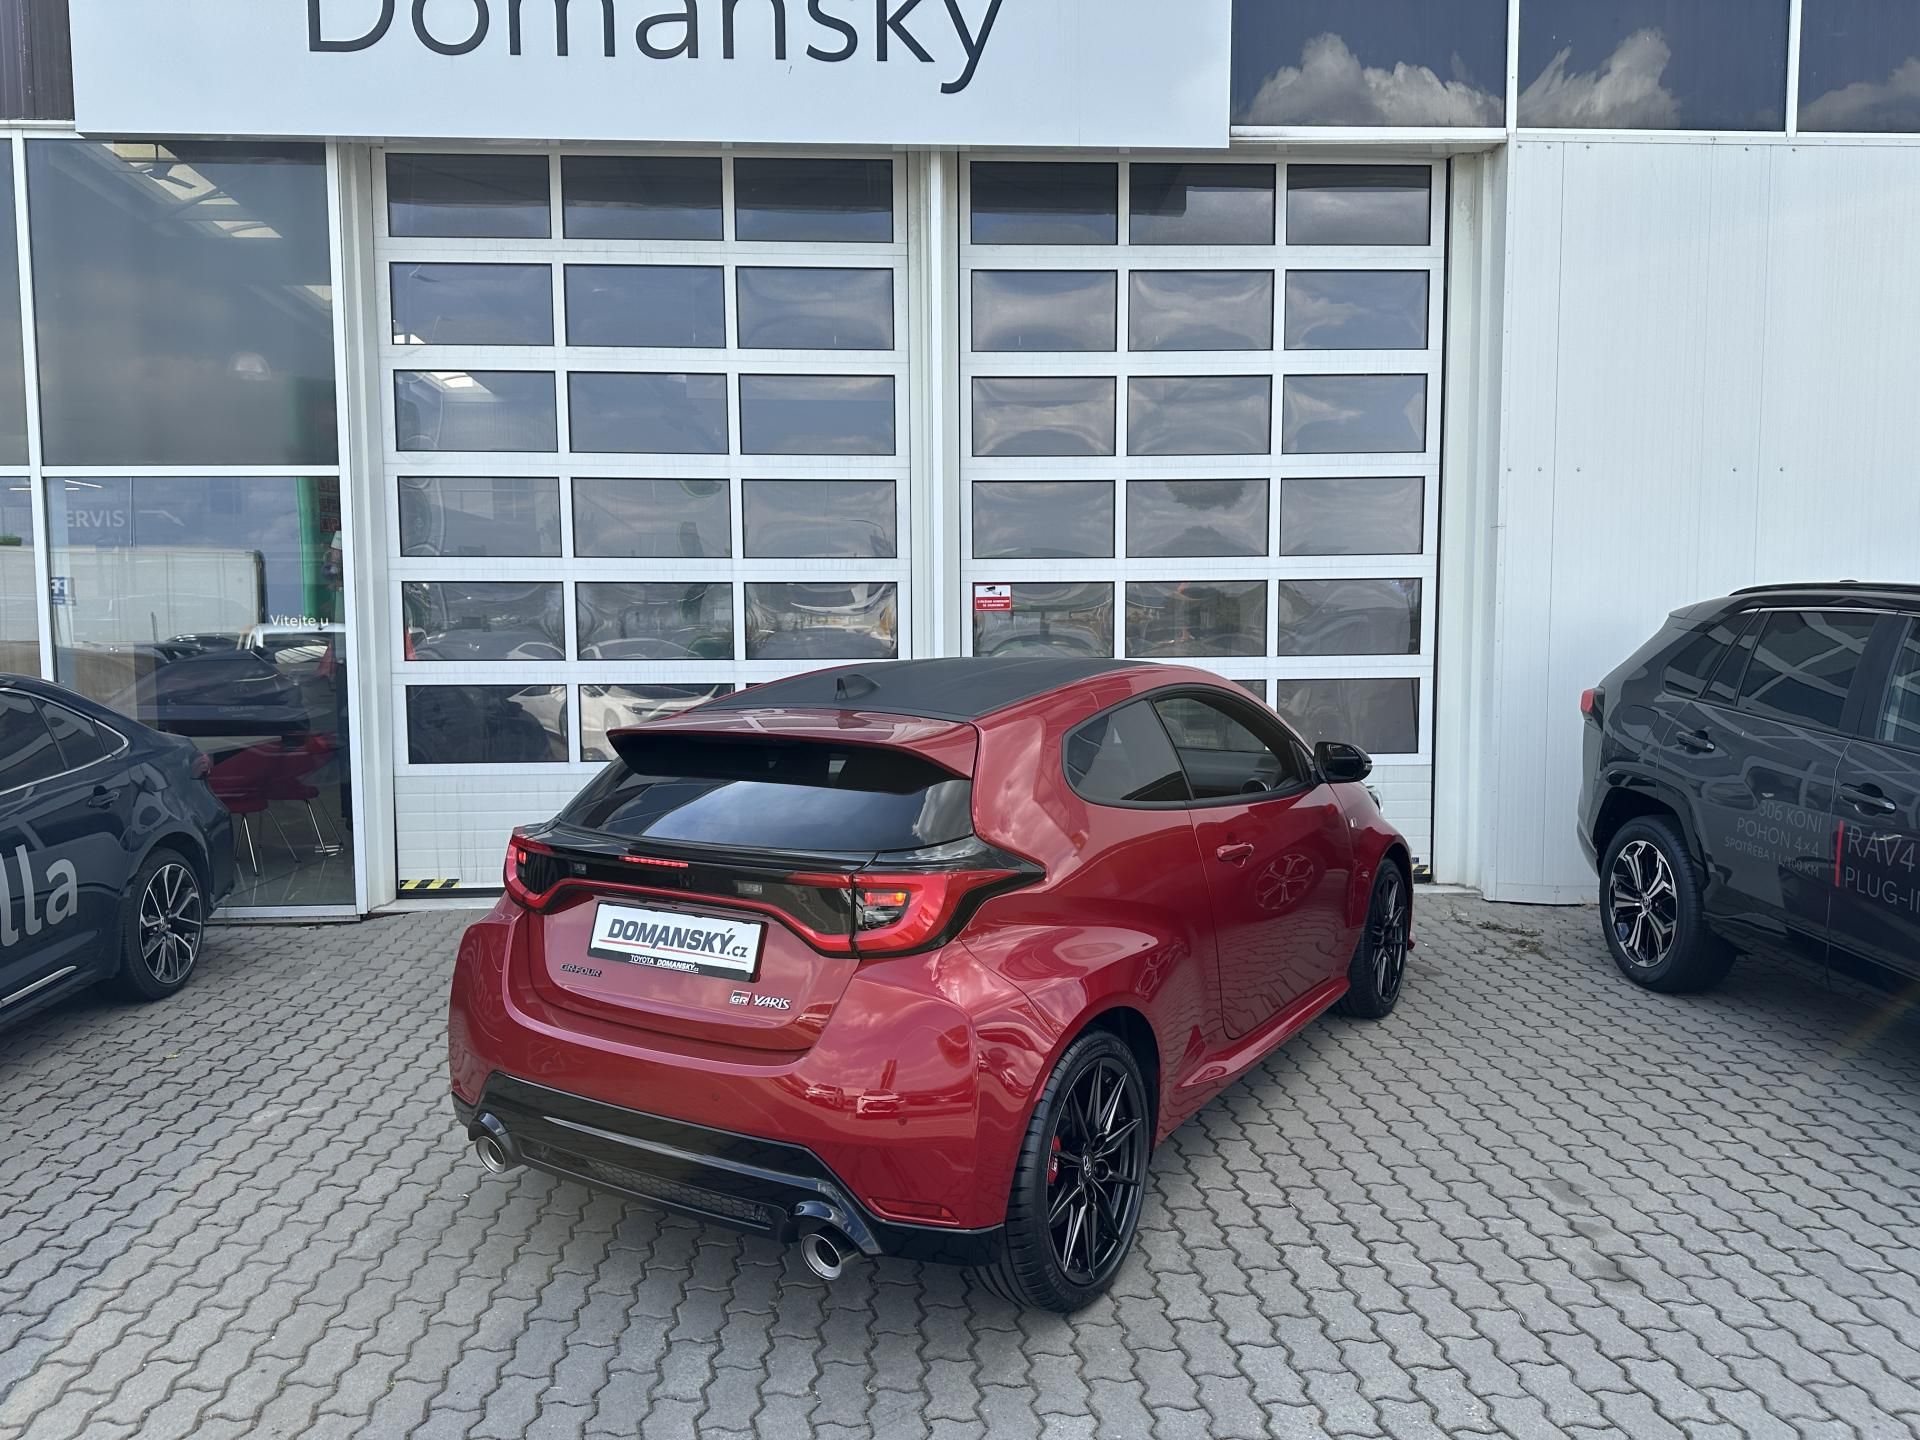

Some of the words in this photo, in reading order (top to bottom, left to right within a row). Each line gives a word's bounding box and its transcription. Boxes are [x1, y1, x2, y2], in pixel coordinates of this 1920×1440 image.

[270, 614, 316, 629] Vítejte
[320, 617, 329, 626] u
[1759, 799, 1784, 822] 306
[1737, 817, 1791, 849] POHON
[1724, 836, 1770, 861] SPOTŘEBA
[1804, 863, 1820, 878] KM
[1847, 825, 1916, 873] RAV4
[1845, 866, 1920, 914] PLUG-I
[630, 954, 654, 965] TOYOTA
[730, 993, 750, 1005] GR
[754, 994, 791, 1010] YARIS
